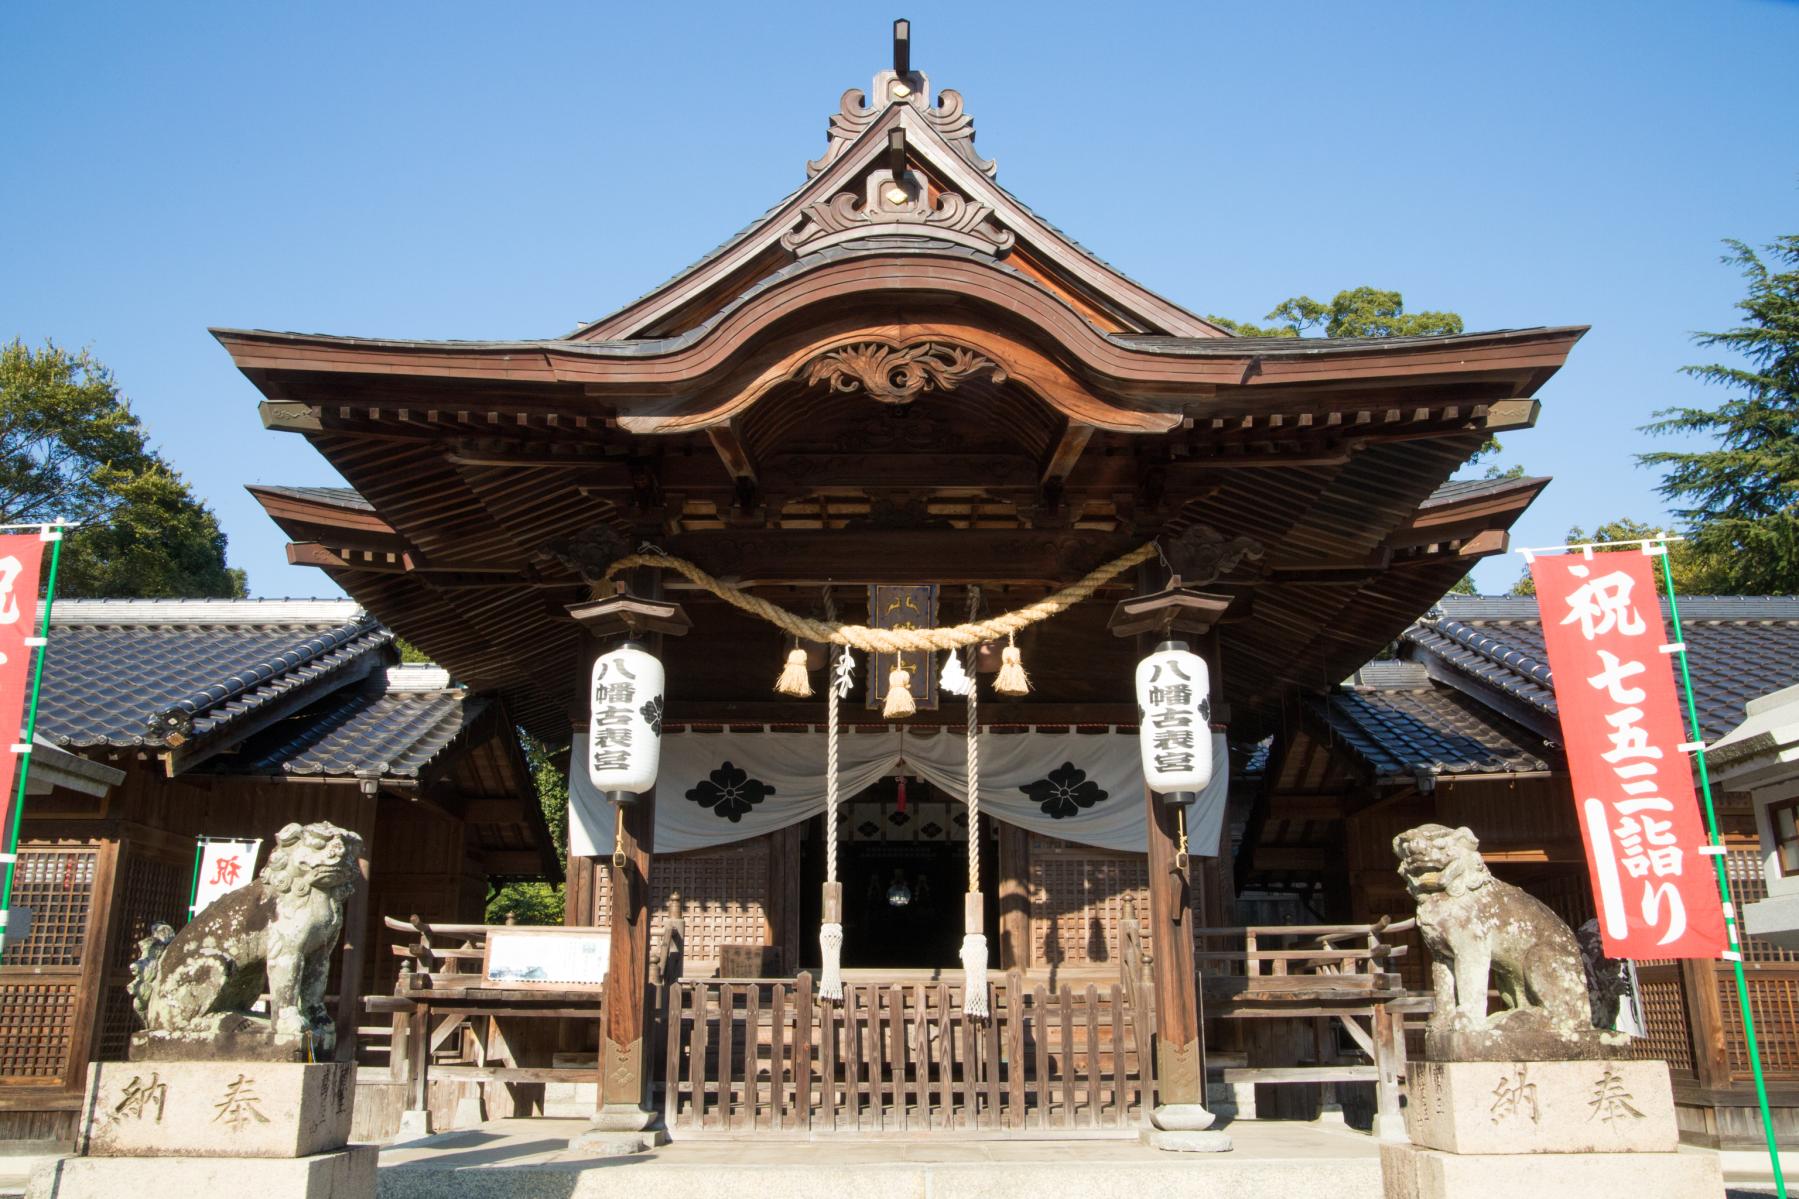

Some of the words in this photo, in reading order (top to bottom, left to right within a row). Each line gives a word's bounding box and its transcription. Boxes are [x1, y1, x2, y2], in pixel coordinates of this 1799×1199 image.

[594, 658, 636, 771] 八幡古表宮
[1149, 659, 1195, 773] 八幡古表宮
